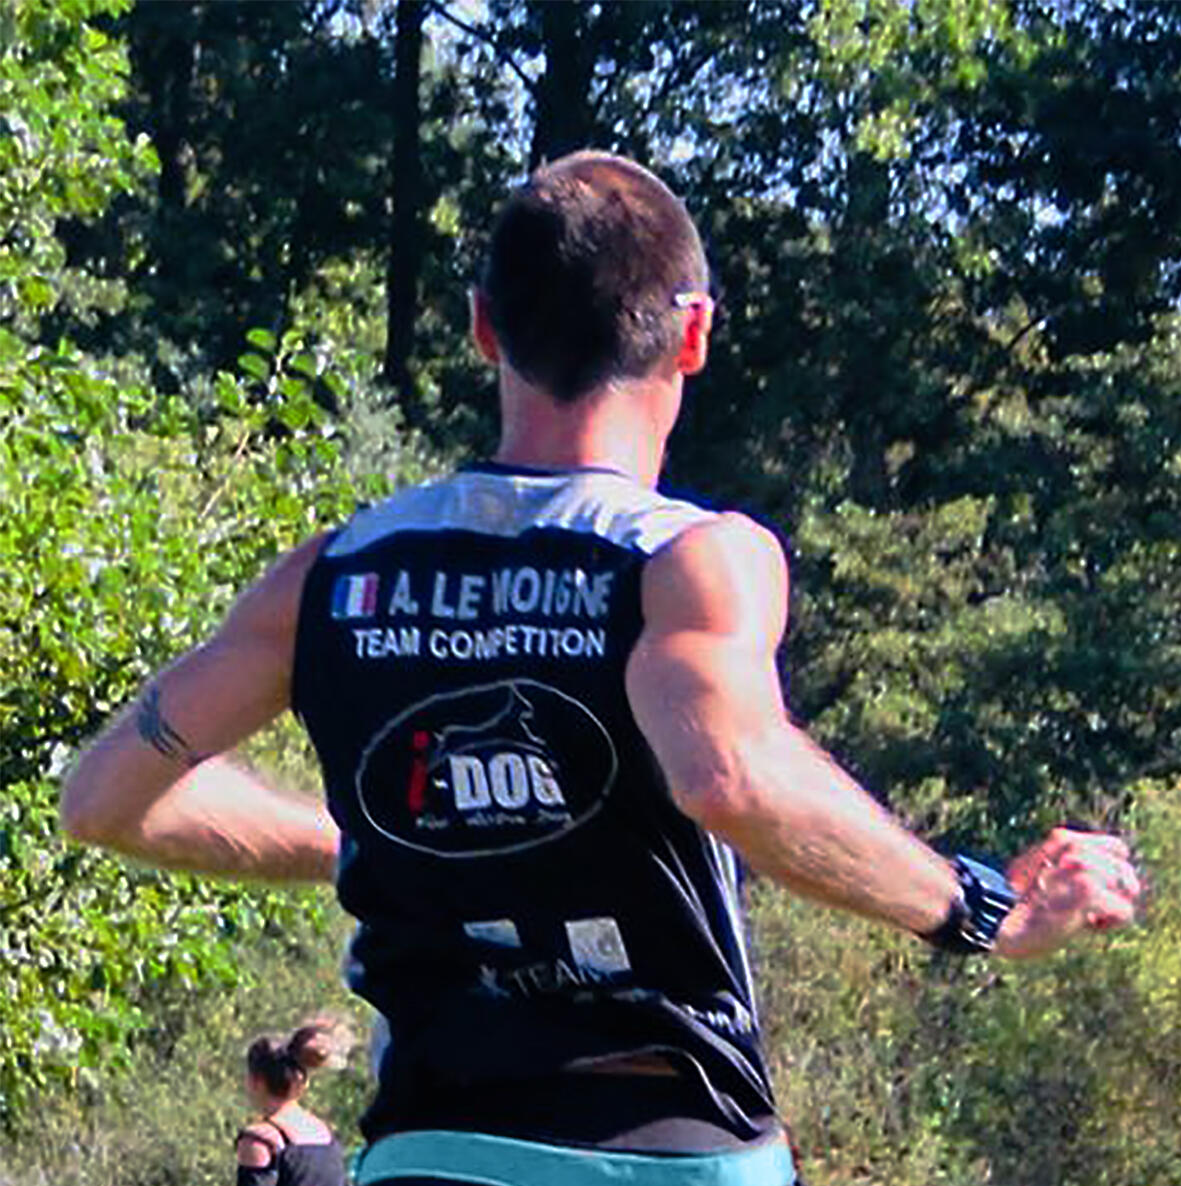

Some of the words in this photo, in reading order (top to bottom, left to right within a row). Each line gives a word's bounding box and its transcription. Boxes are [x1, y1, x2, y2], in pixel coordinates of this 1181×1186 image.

[388, 568, 420, 616] A.
[431, 571, 487, 621] LE
[352, 626, 421, 659] TEAM
